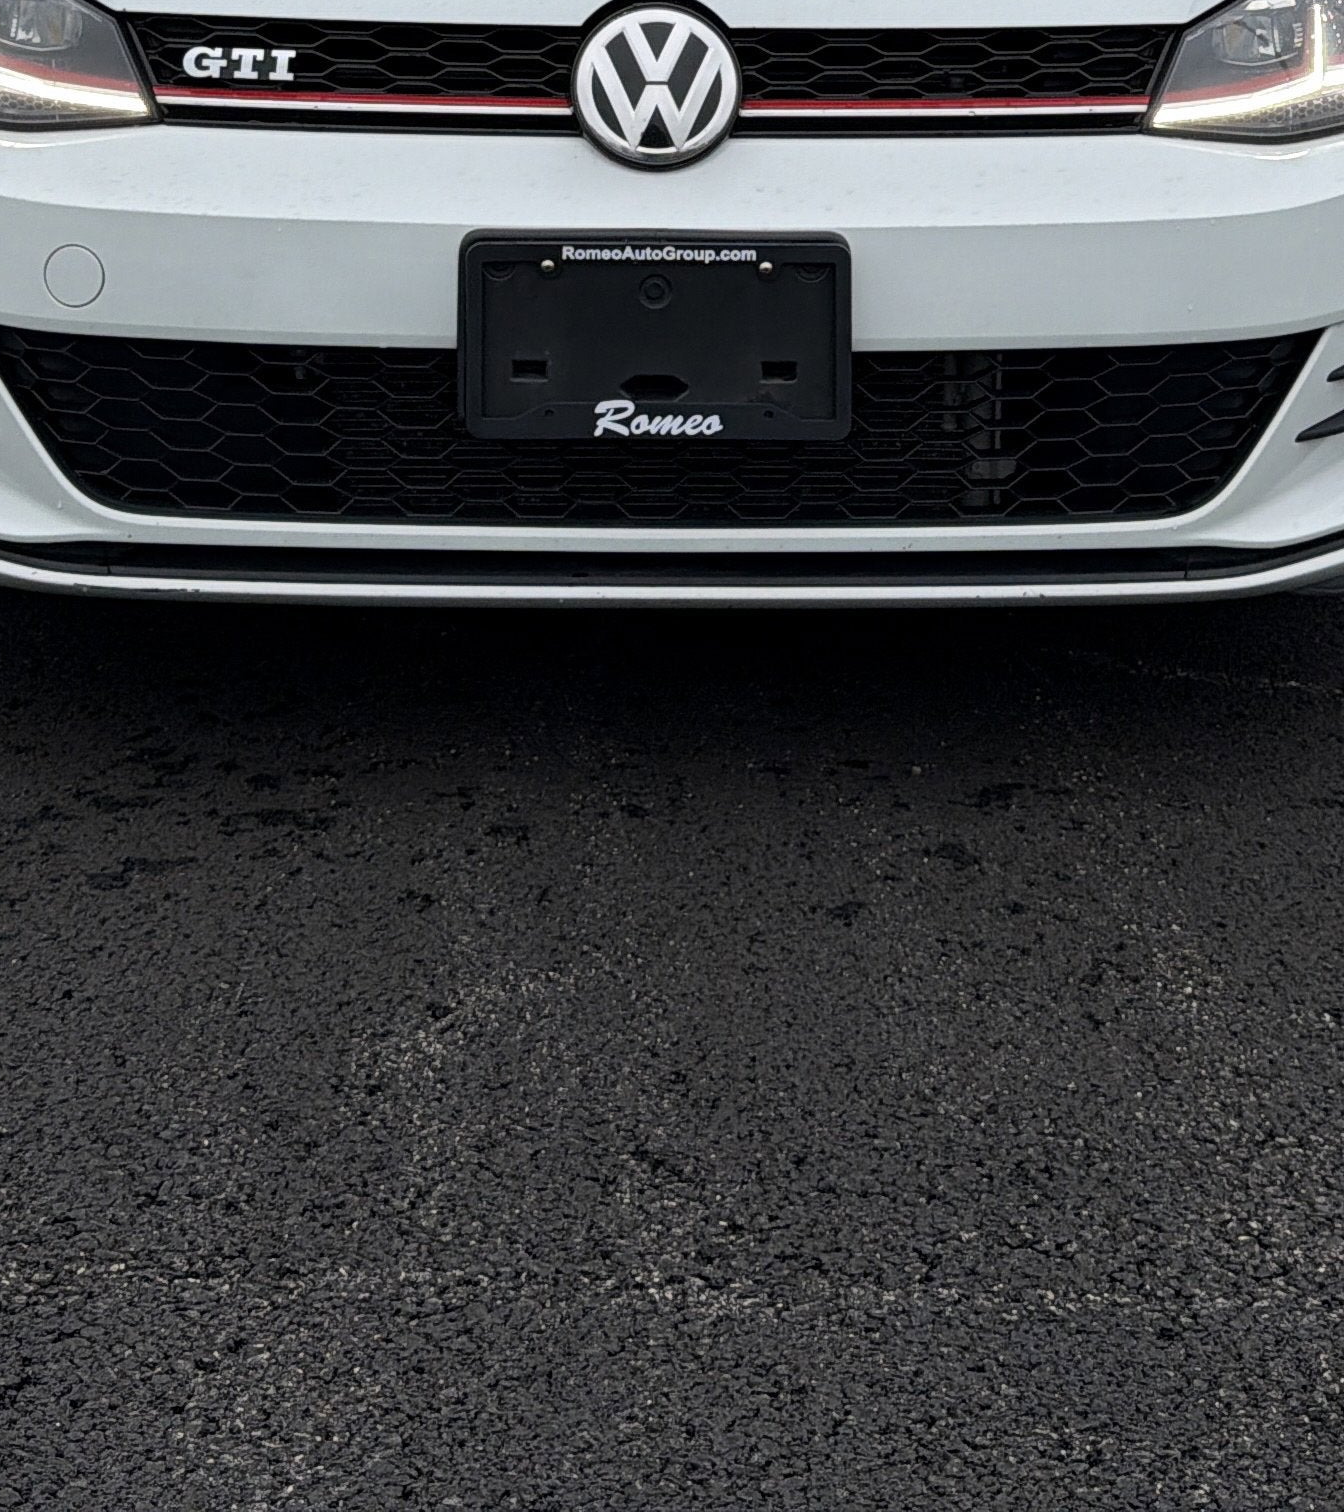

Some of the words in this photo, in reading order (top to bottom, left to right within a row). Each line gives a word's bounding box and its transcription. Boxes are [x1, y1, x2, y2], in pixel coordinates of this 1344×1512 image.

[182, 46, 297, 80] GTI
[578, 9, 737, 161] VW
[562, 245, 757, 264] RomeoAutoGroup.com
[593, 399, 723, 437] Romeo
